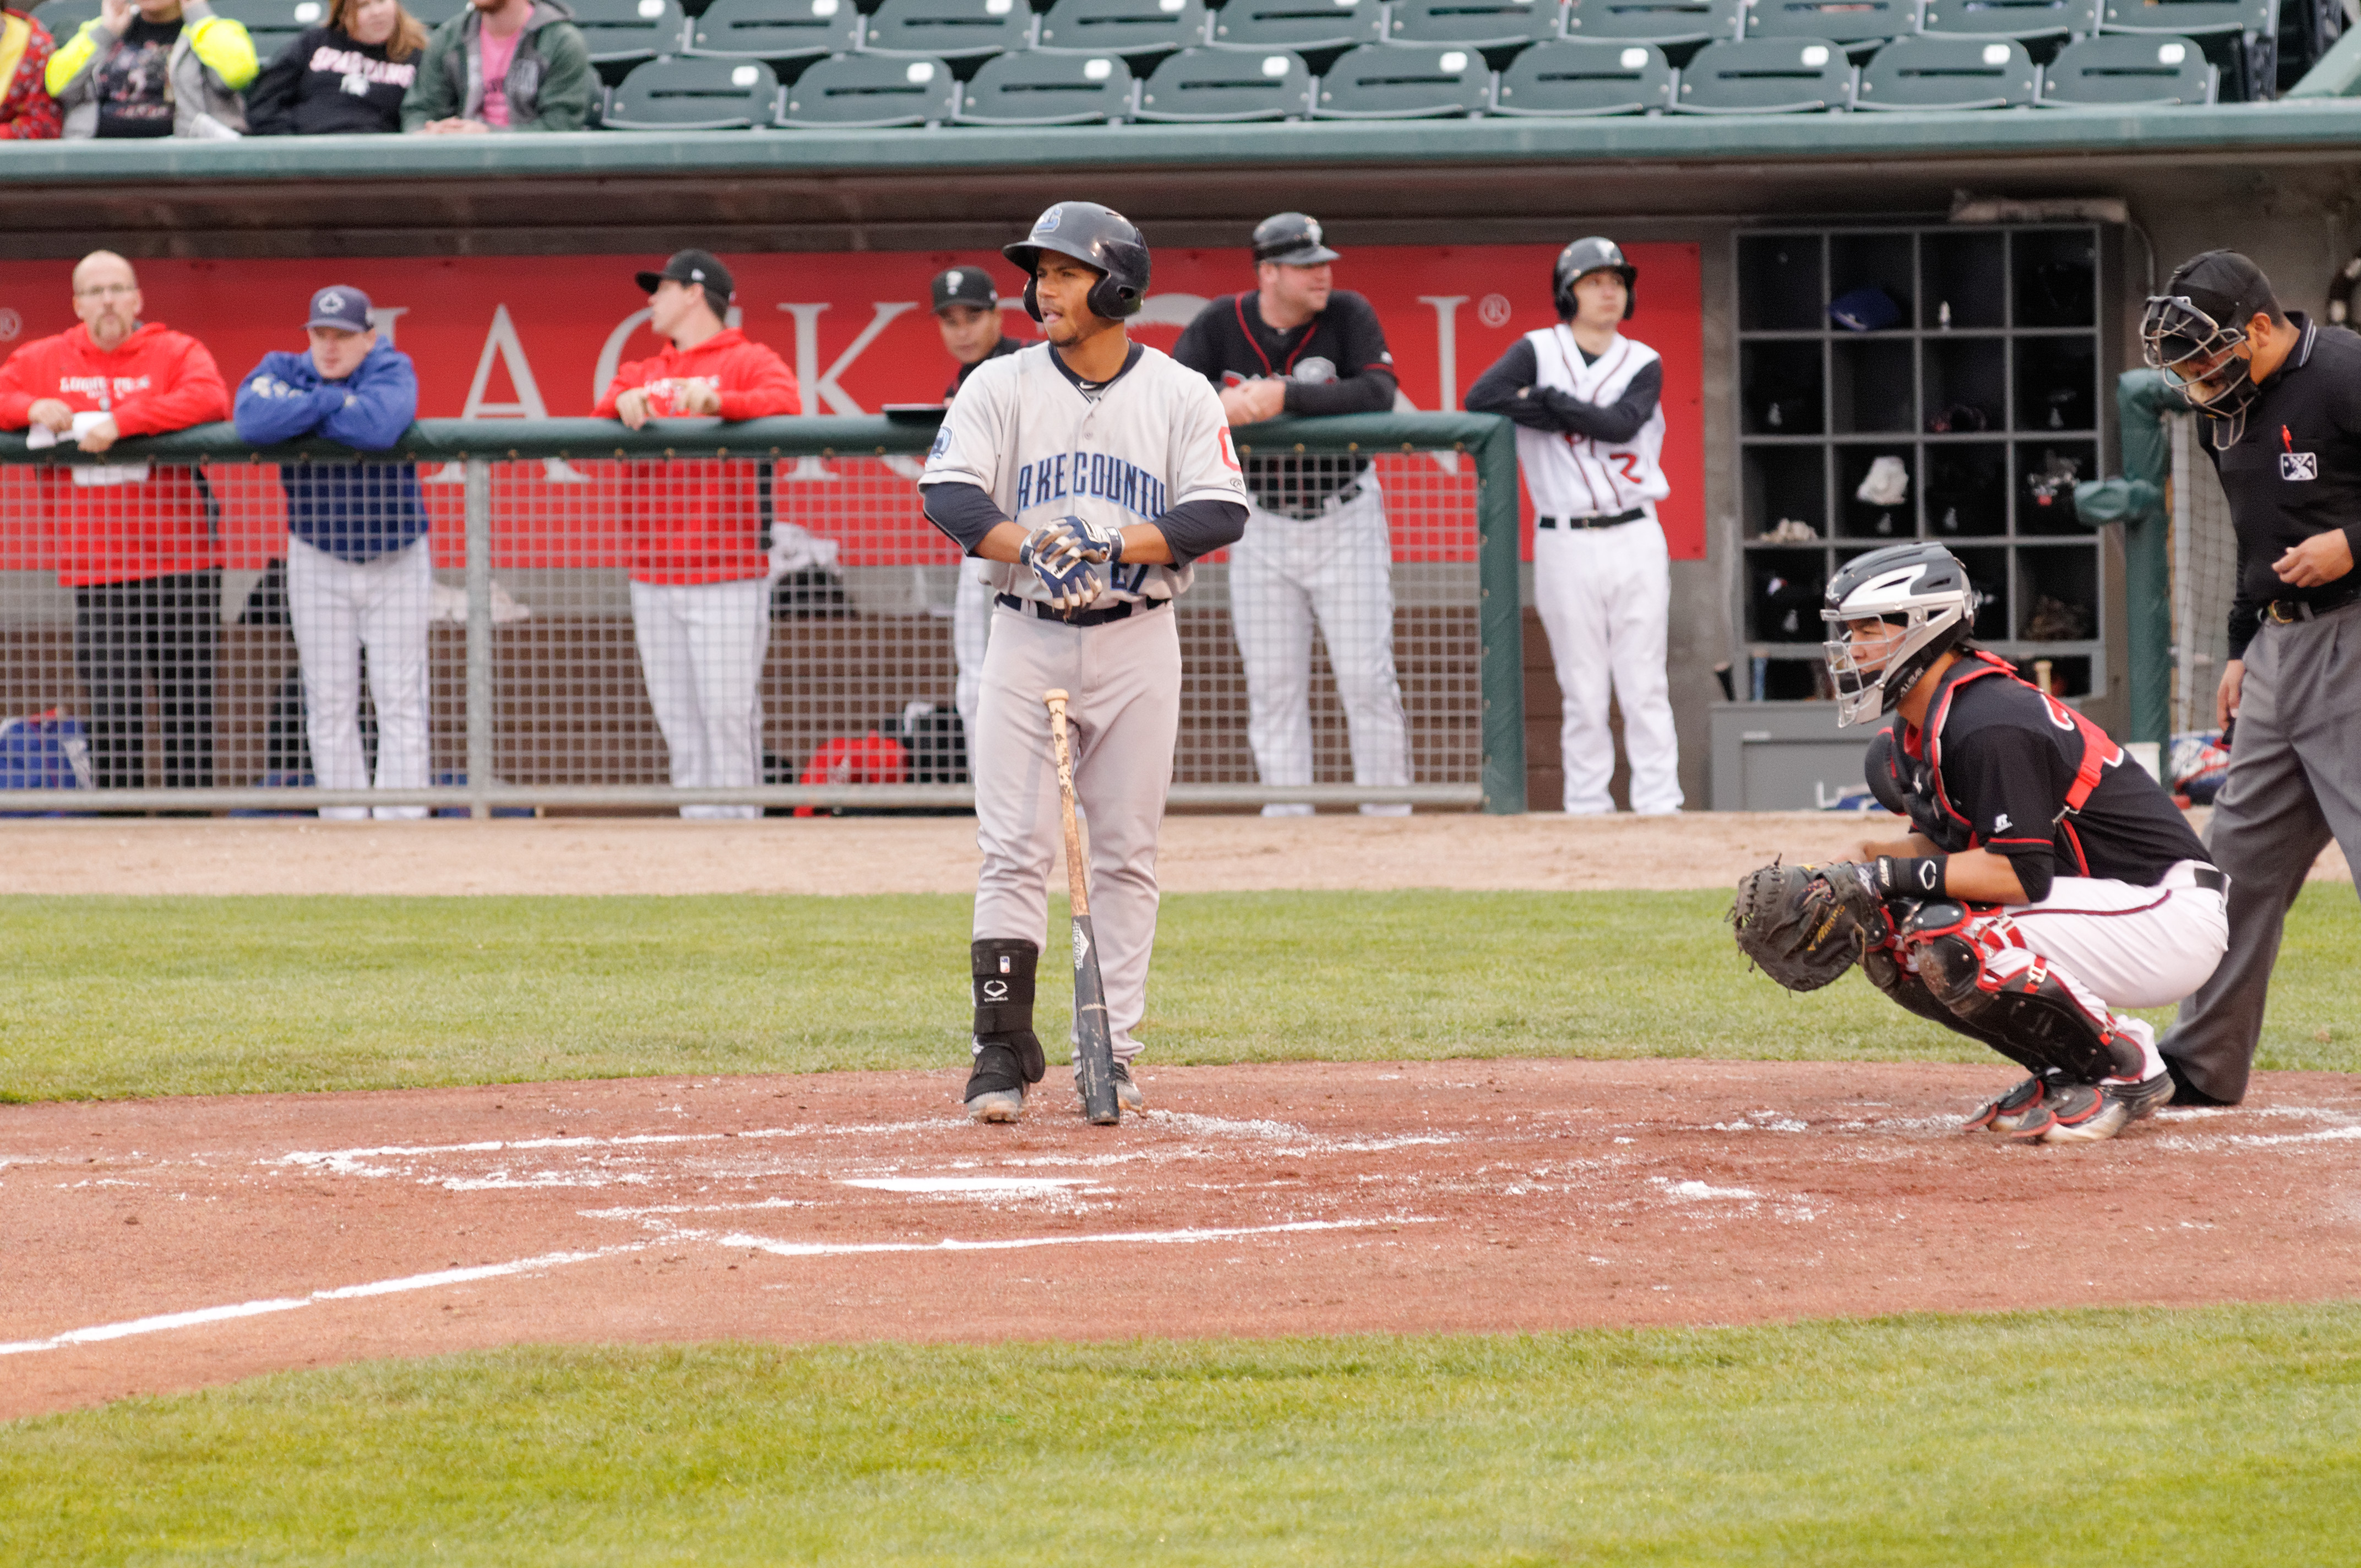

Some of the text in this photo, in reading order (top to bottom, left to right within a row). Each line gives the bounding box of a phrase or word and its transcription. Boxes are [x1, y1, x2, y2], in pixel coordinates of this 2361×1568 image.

[309, 46, 416, 89] SPARTANS
[1014, 453, 1067, 522] AKE
[1072, 922, 1084, 970] HICKORY
